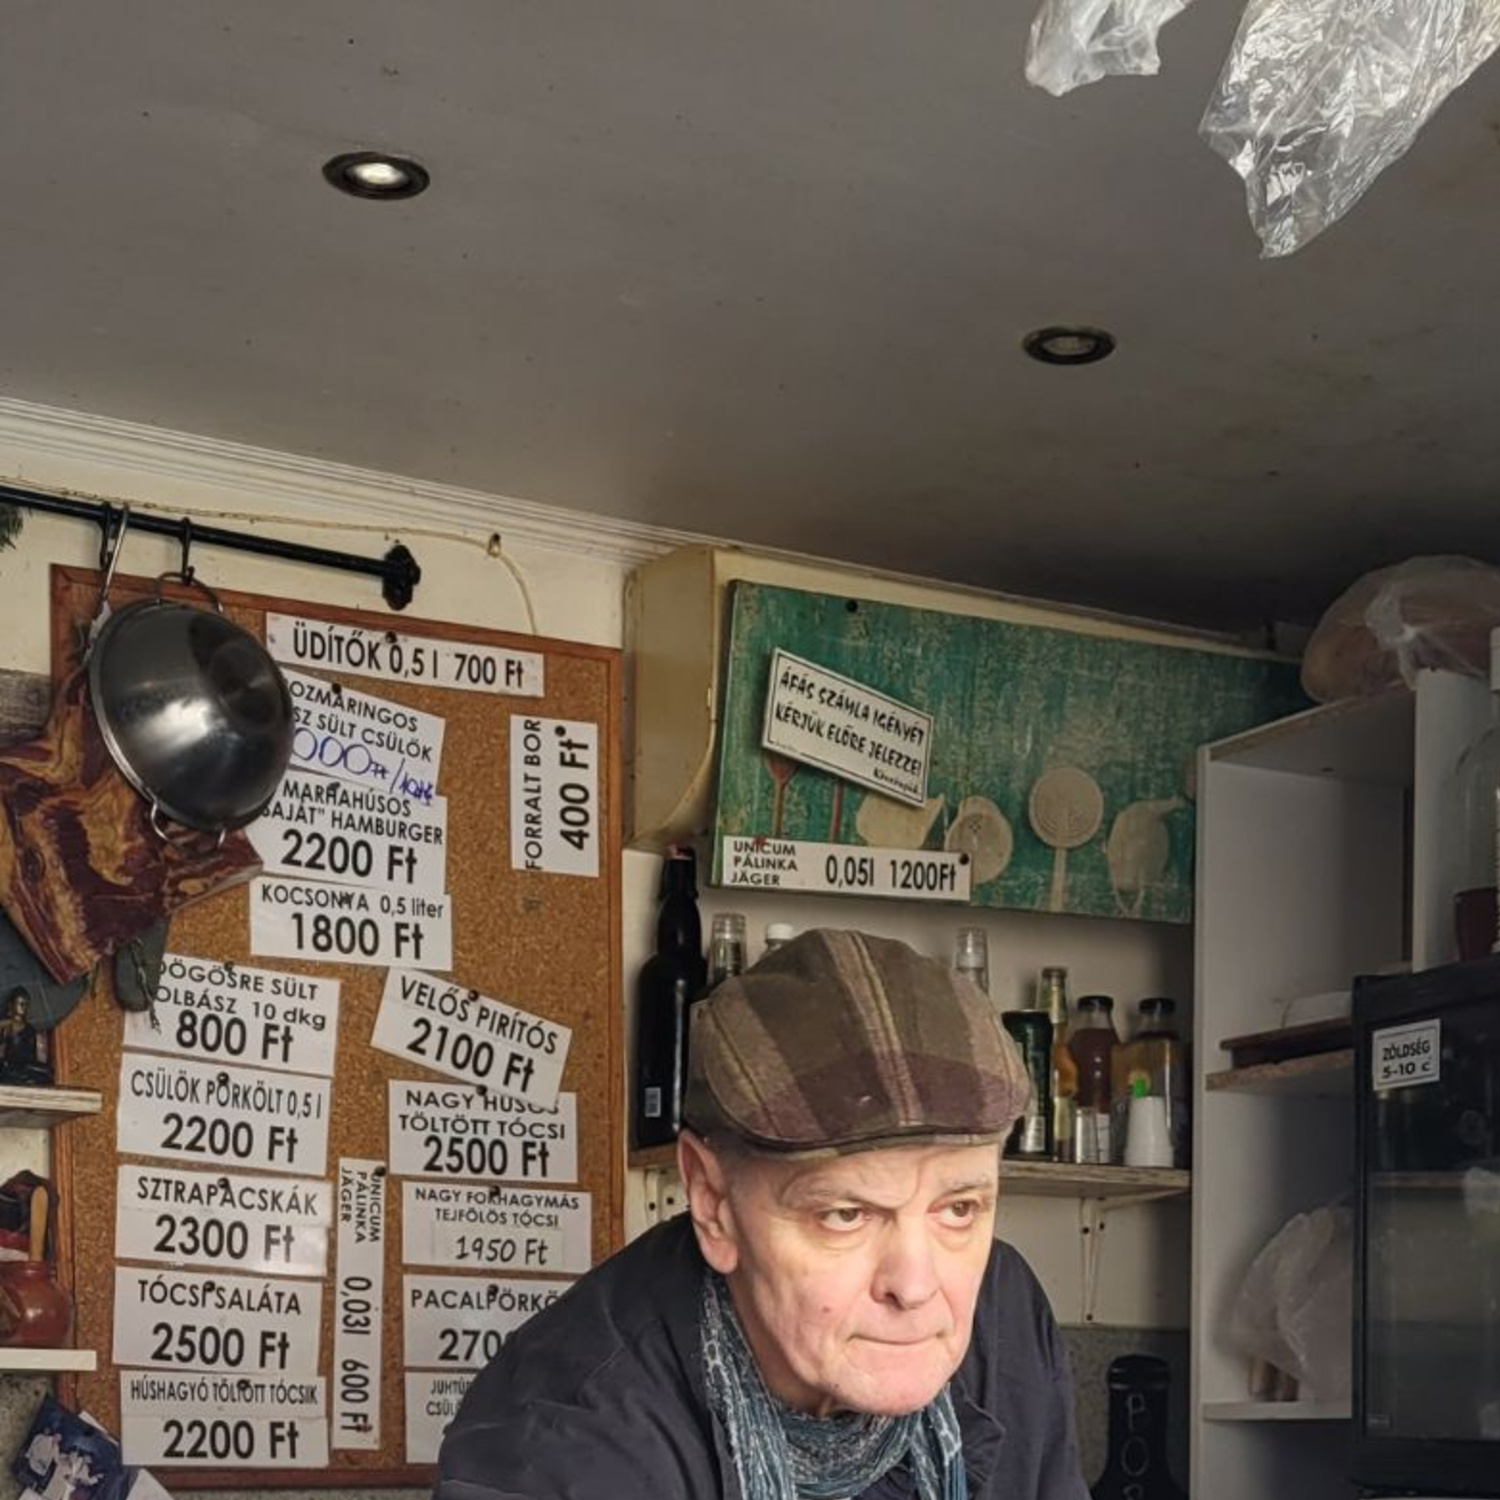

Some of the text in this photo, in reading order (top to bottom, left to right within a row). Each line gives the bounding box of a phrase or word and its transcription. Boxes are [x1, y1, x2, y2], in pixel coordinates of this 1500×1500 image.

[293, 621, 381, 671] ÜDÍTŐK
[389, 645, 424, 677] 0,5
[454, 653, 496, 685] 700
[506, 659, 524, 688] Ft
[317, 713, 357, 738] SÜLT
[361, 728, 432, 762] CSÜLÖK
[775, 701, 823, 738] KÉRJÜK
[819, 689, 870, 721] SZÁMLA
[873, 710, 924, 746] IGÉNYÉT
[282, 778, 412, 817] MARHAHÚSOS
[523, 719, 543, 871] FORRALT BOR
[559, 739, 590, 850] 400 Ft
[331, 811, 443, 845] HAMBURGER
[733, 840, 796, 856] UNICUM
[281, 829, 418, 884] 2200 Ft
[733, 855, 798, 872] PÁLINKA
[731, 871, 780, 886] JÄGER
[262, 884, 444, 918] KOCSONYA 0,5 liter
[292, 912, 424, 960] 1800 Ft
[271, 977, 318, 1001] SÜLT
[176, 1009, 294, 1062] 800 Ft
[252, 1001, 277, 1020] 10
[283, 1007, 326, 1031] dkg
[401, 975, 558, 1054] VELŐS PIRÍTÓS
[406, 1017, 534, 1092] 2100 Ft
[131, 1067, 200, 1103] CSÜLÖK
[206, 1076, 283, 1114] PÖRKÖLT
[287, 1090, 312, 1120] 0,5
[406, 1090, 474, 1110] NAGY
[161, 1113, 298, 1163] 2200 Ft
[399, 1111, 565, 1139] TÖLTÖTT TÓCSI
[423, 1135, 549, 1177] 2500 Ft
[137, 1176, 318, 1216] SZTRAPACSKÁK
[341, 1168, 353, 1223] JÄGER
[355, 1171, 368, 1243] PÁLINKA
[369, 1172, 382, 1242] UNICUM
[415, 1187, 579, 1210] NAGY FOKHAGYMÁS
[154, 1214, 295, 1262] 2300 Ft
[435, 1207, 558, 1227] TEJFÖLÖS TÓCSI
[456, 1235, 548, 1266] 1950 Ft
[151, 1322, 289, 1369] 2500 Ft
[130, 1375, 318, 1405] HÚSHAGYÓ TÖLTÖTT TÓCSIK
[341, 1359, 369, 1403] 600
[163, 1419, 299, 1459] 2200 Ft
[341, 1412, 373, 1432] Ft
